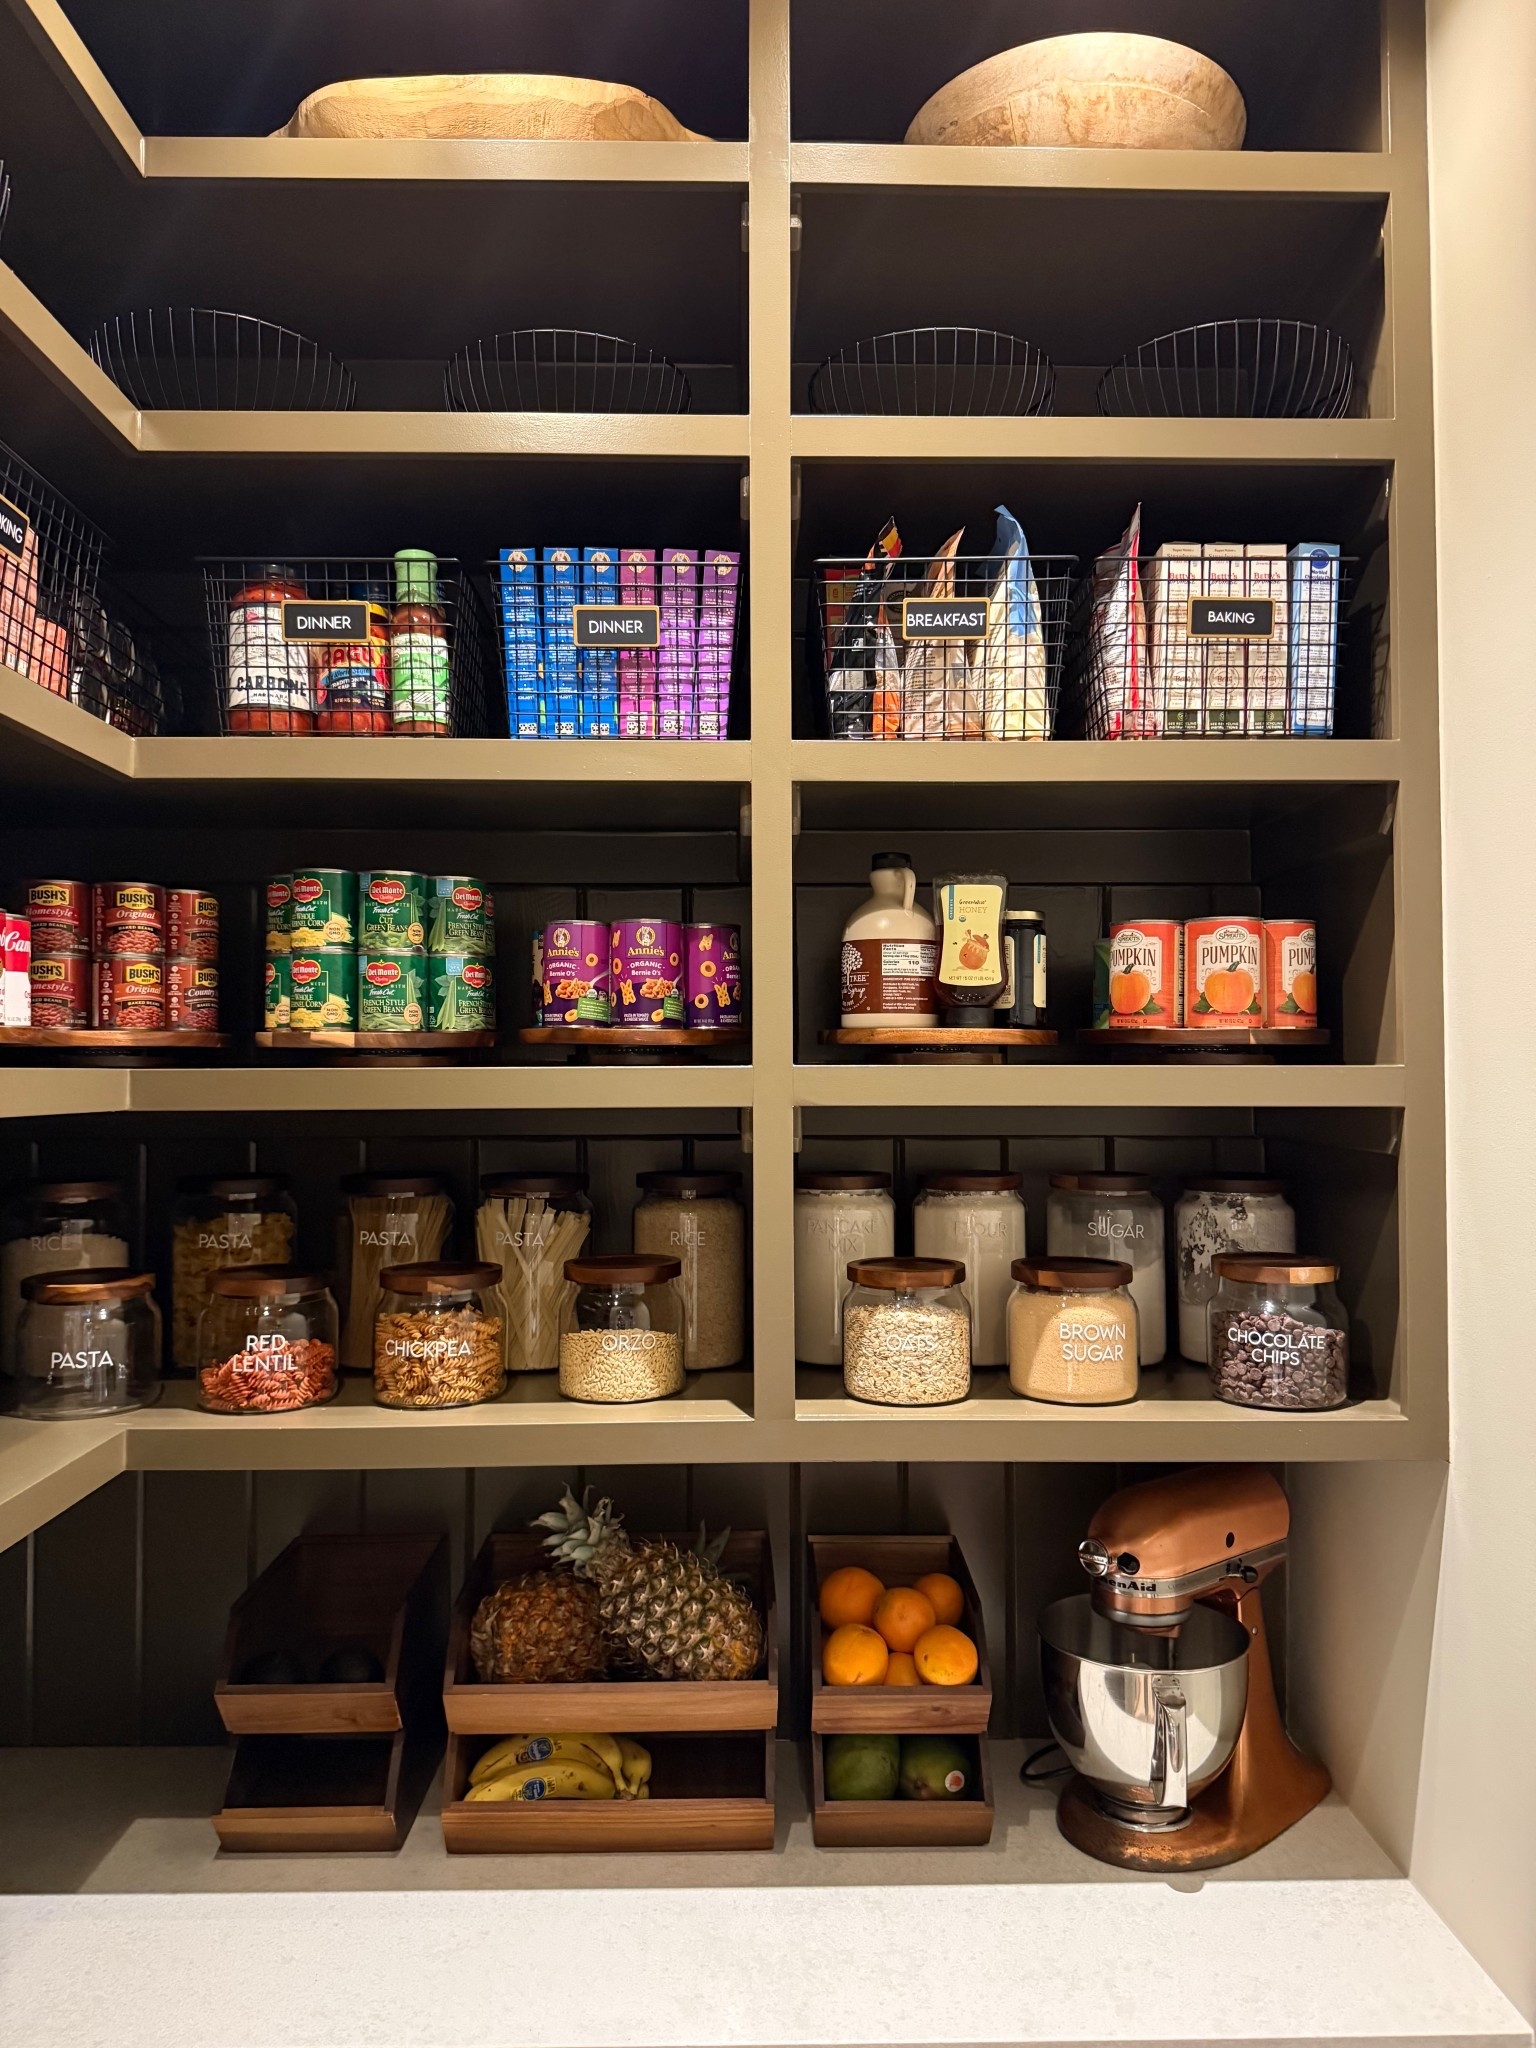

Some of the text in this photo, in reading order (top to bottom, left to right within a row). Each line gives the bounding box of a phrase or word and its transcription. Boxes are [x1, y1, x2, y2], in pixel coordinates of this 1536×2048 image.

[0, 512, 23, 544] KING
[297, 616, 351, 630] DINNER
[907, 612, 986, 627] BREAKFAST
[1207, 610, 1256, 624] BAKING
[588, 620, 644, 634] DINNER
[237, 675, 307, 697] CARBONE
[31, 889, 67, 902] BUSH'S
[301, 885, 320, 893] Monte
[371, 886, 403, 895] Del Monte
[119, 892, 154, 906] BUSH'S
[116, 909, 156, 920] Original
[296, 912, 316, 920] WHOLE
[959, 906, 988, 914] HONEY
[291, 919, 326, 928] ERNEL CORN
[379, 915, 394, 924] CUT
[448, 921, 472, 930] FRENCH
[366, 923, 408, 932] GREEN BEANS
[448, 928, 470, 937] GREEN
[547, 946, 580, 957] Annie's
[628, 945, 665, 957] Annie's
[1202, 945, 1258, 966] PUMPKIN
[299, 966, 318, 974] Monte
[548, 962, 577, 970] ORGANIC
[630, 960, 663, 969] ORGANIC
[129, 968, 160, 981] BUSH'S
[368, 968, 399, 976] Del Monte
[465, 970, 474, 978] Del
[850, 974, 867, 983] TREE
[31, 982, 69, 992] mestyle
[126, 984, 162, 995] Original
[290, 1000, 324, 1008] ERNEL CORN
[363, 998, 406, 1006] FRENCH STYLE
[458, 999, 480, 1007] FRENCH
[363, 1005, 405, 1014] GREEN BEANS
[460, 1006, 478, 1014] GREEN
[807, 1218, 877, 1235] PANCAKE
[954, 1220, 1008, 1238] FLOUR
[1087, 1221, 1145, 1240] SUGAR
[31, 1236, 72, 1252] RICE
[199, 1233, 252, 1249] PASTA
[360, 1230, 411, 1246] PASTA
[495, 1231, 545, 1247] PASTA
[670, 1231, 706, 1246] RICE
[828, 1237, 858, 1252] MIX
[1059, 1322, 1126, 1342] BROWN
[1227, 1327, 1326, 1350] CHOCOLATE
[246, 1334, 286, 1352] RED
[602, 1333, 657, 1351] ORZO
[886, 1334, 936, 1351] OATS
[385, 1339, 472, 1359] CHICKPEA
[1062, 1343, 1124, 1363] SUGAR
[50, 1350, 114, 1370] PASTA
[233, 1353, 299, 1373] LENTIL
[1251, 1348, 1300, 1366] CHIPS
